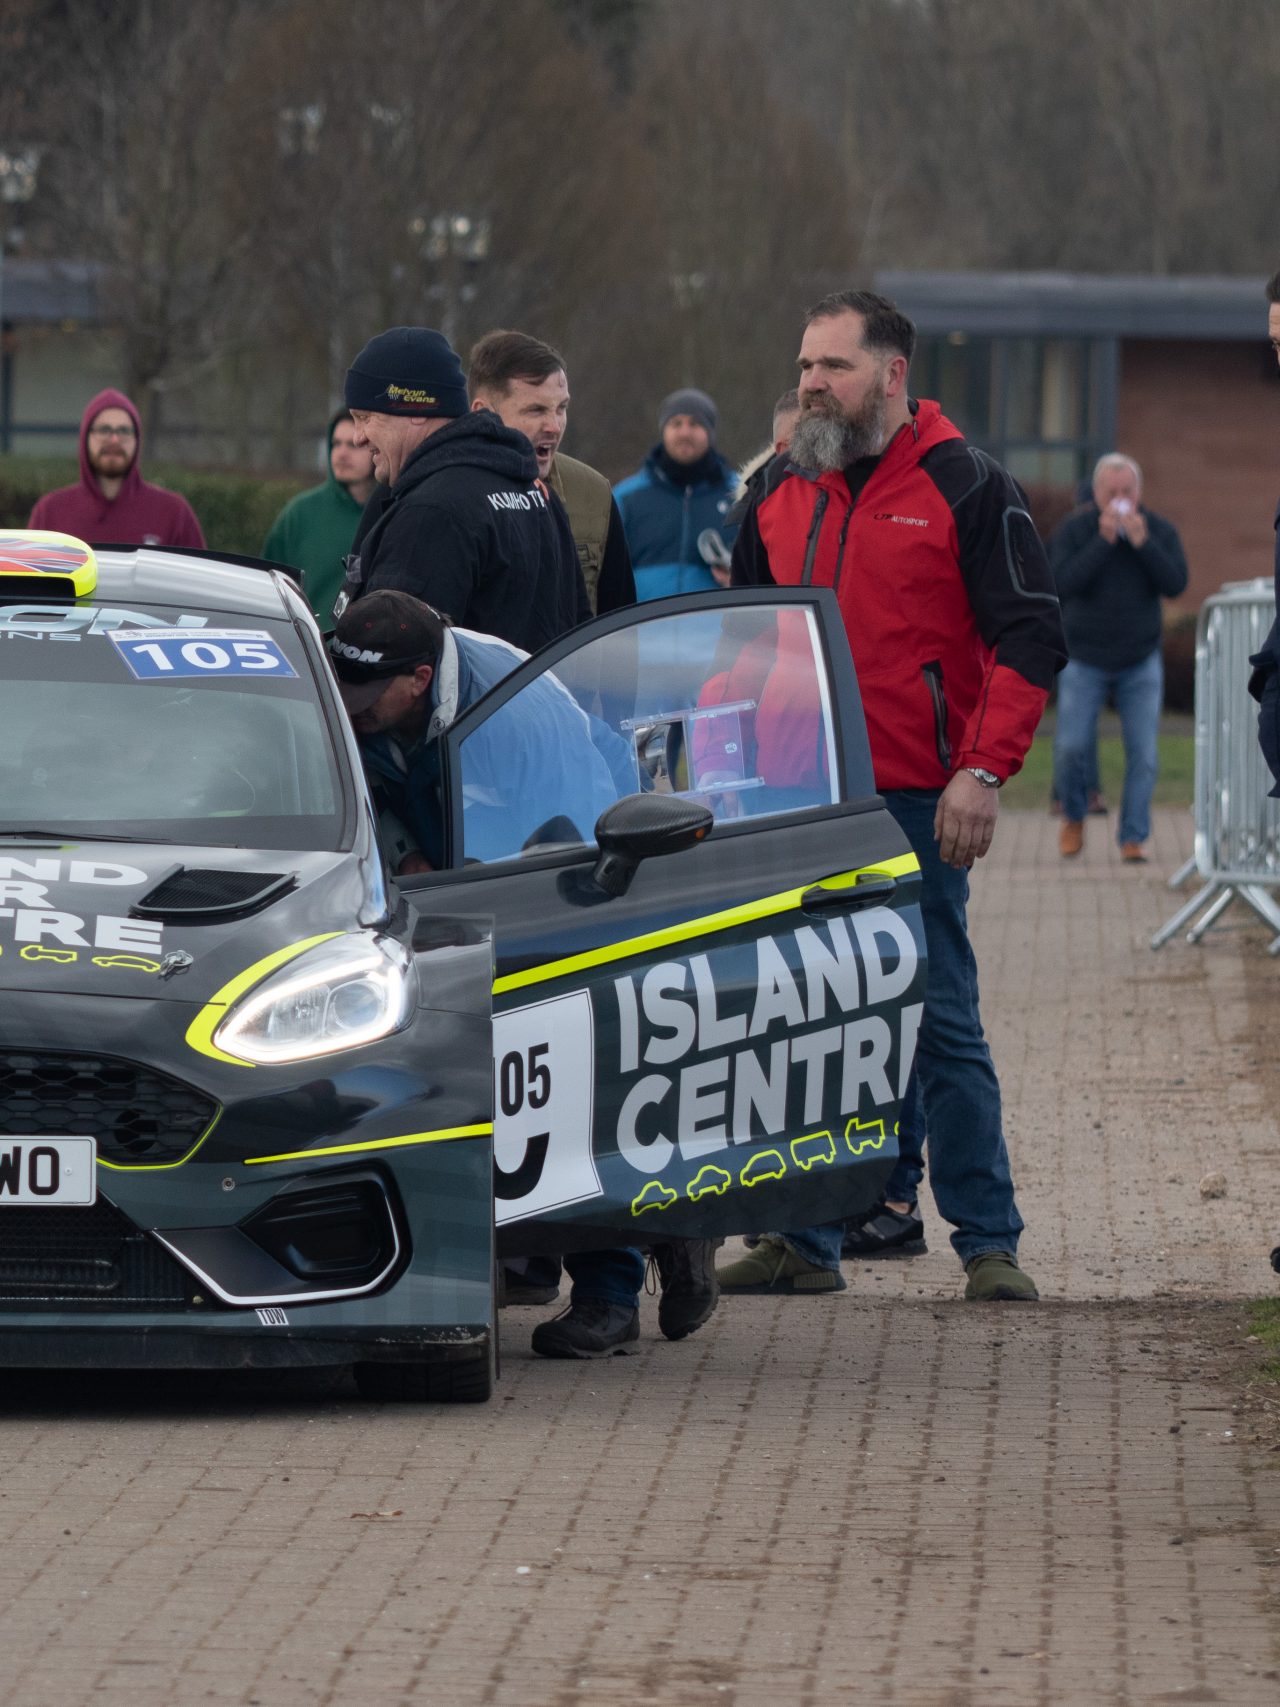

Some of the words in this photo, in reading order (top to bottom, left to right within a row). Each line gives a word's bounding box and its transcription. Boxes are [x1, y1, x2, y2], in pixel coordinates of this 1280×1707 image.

[486, 491, 531, 511] KUMHO
[526, 490, 545, 508] T
[132, 642, 280, 671] 105
[332, 635, 384, 663] VON
[614, 905, 918, 1074] ISLAND
[493, 1042, 551, 1117] 05
[257, 1308, 286, 1324] TOW
